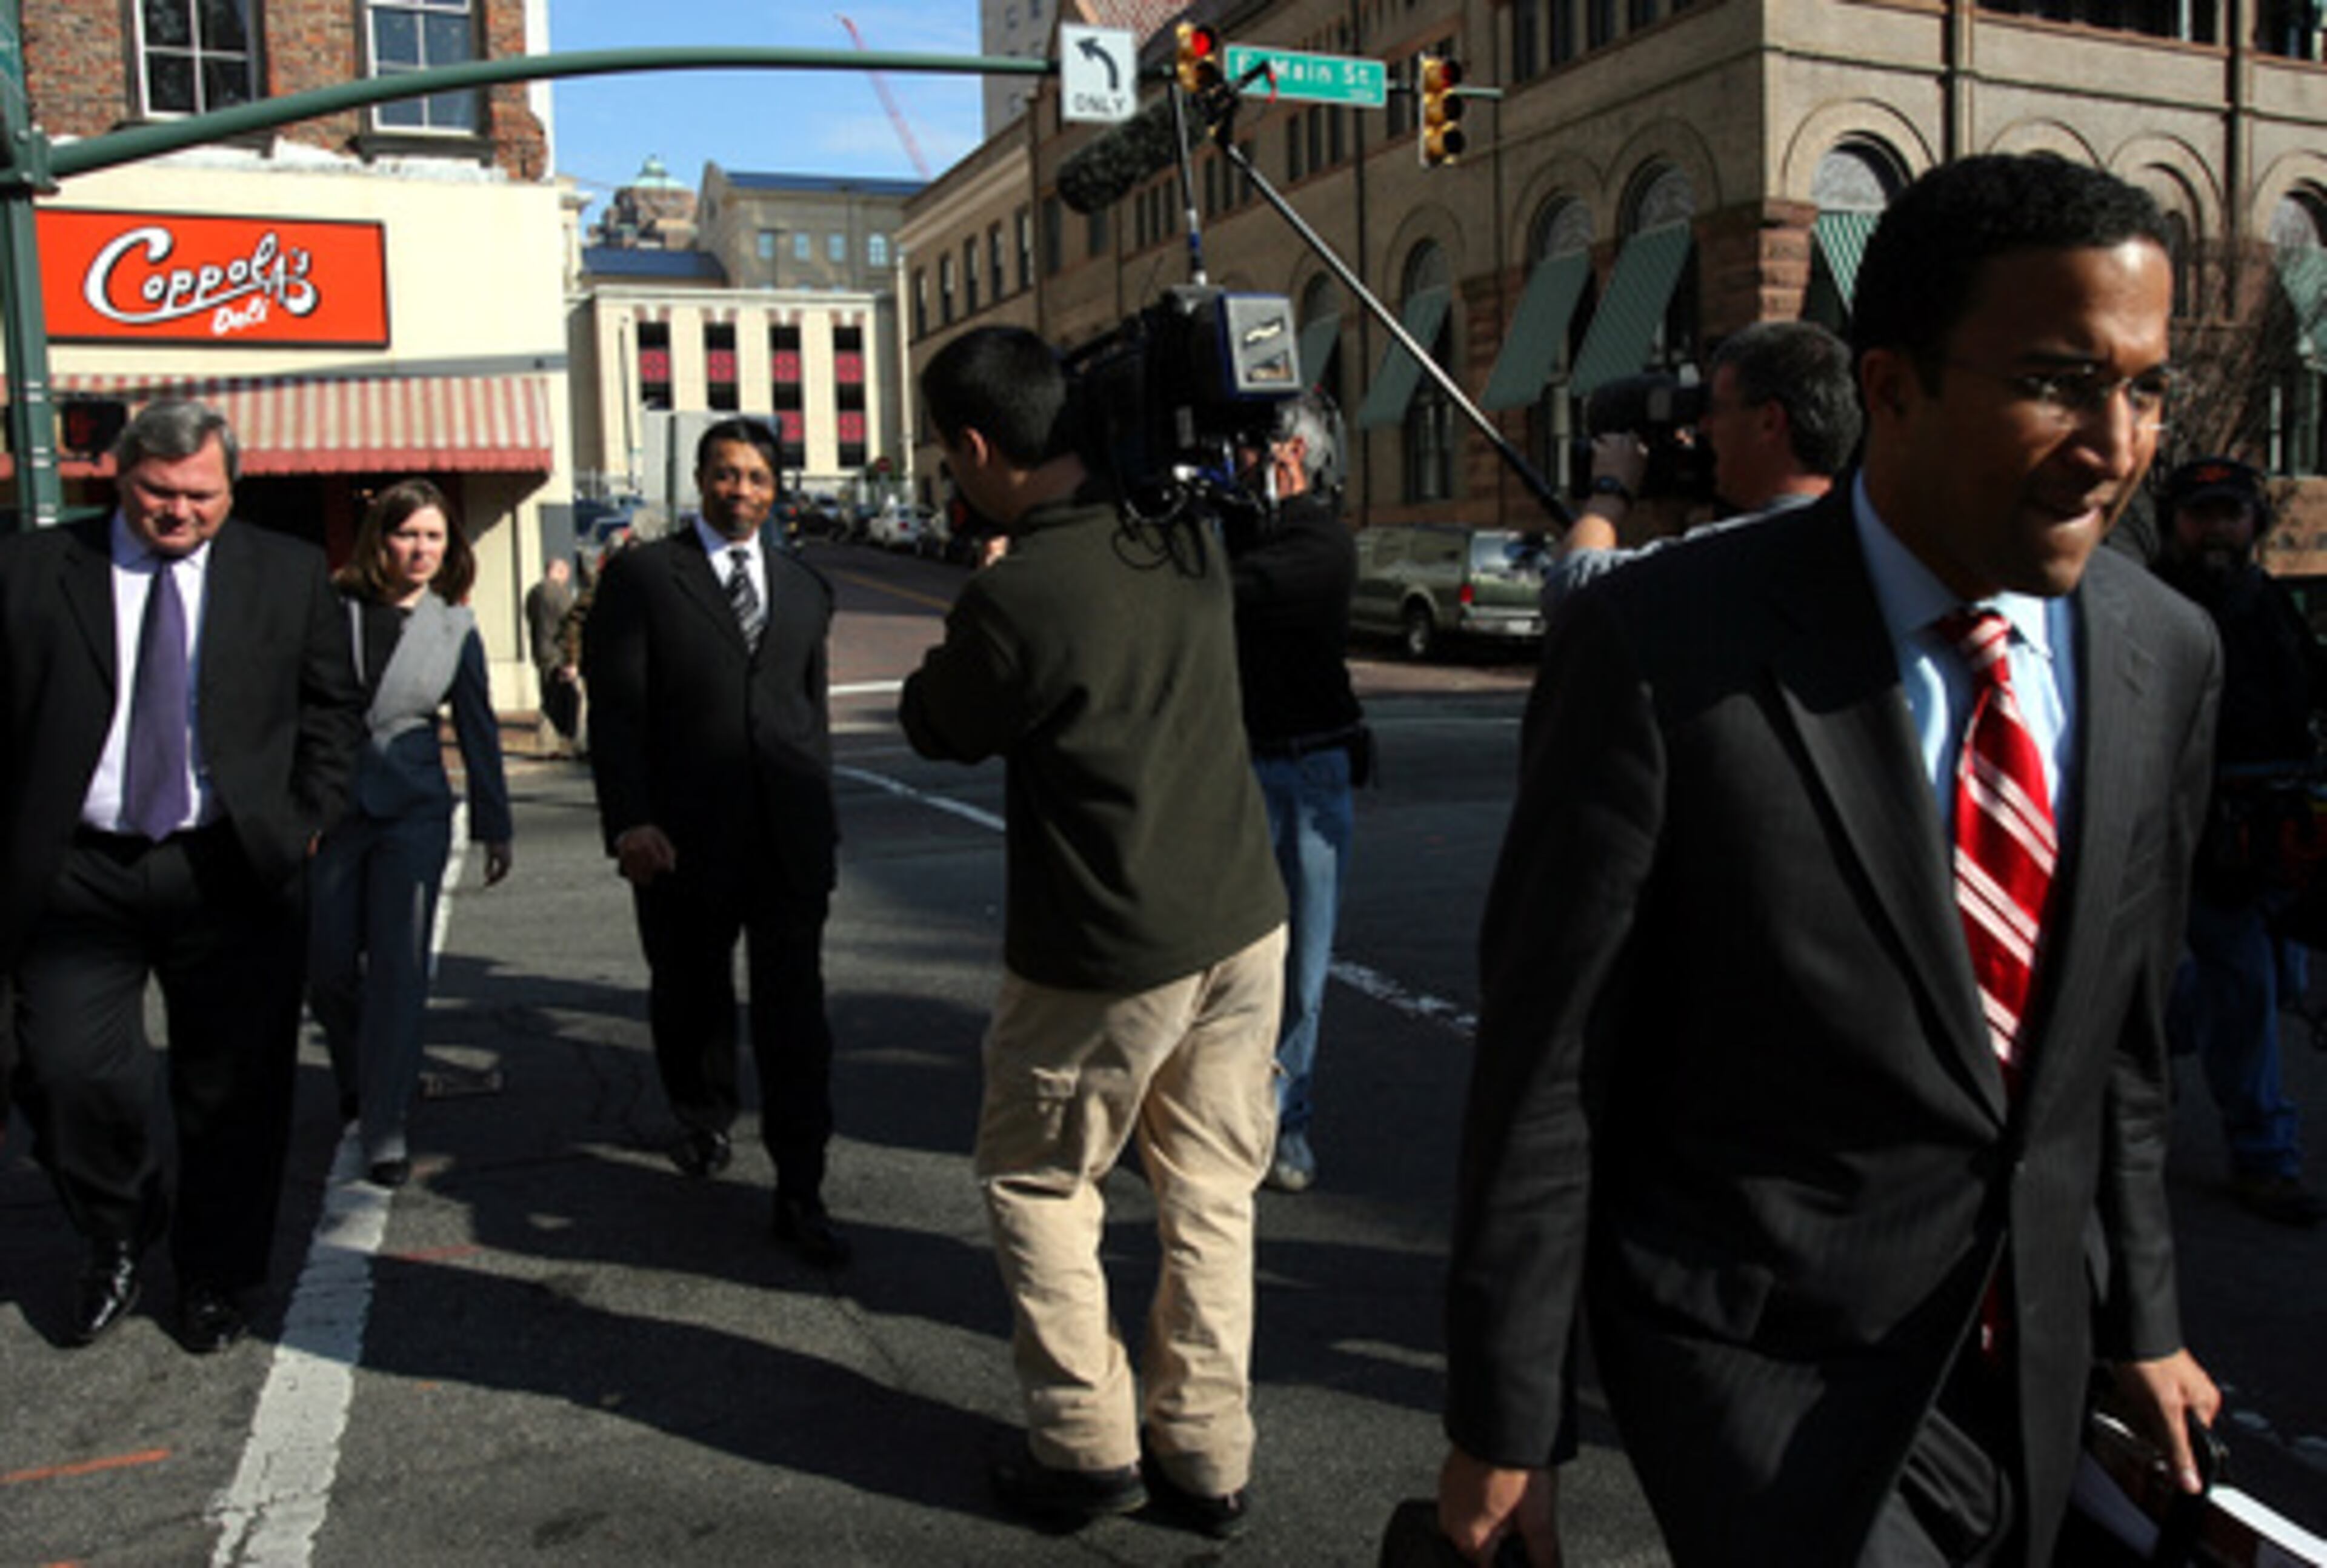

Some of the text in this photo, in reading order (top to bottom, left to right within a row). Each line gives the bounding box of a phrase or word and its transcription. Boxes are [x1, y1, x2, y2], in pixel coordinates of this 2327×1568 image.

[1270, 59, 1333, 84] Main
[1343, 64, 1370, 85] St
[1074, 92, 1127, 116] ONLY
[211, 296, 270, 336] Deli
